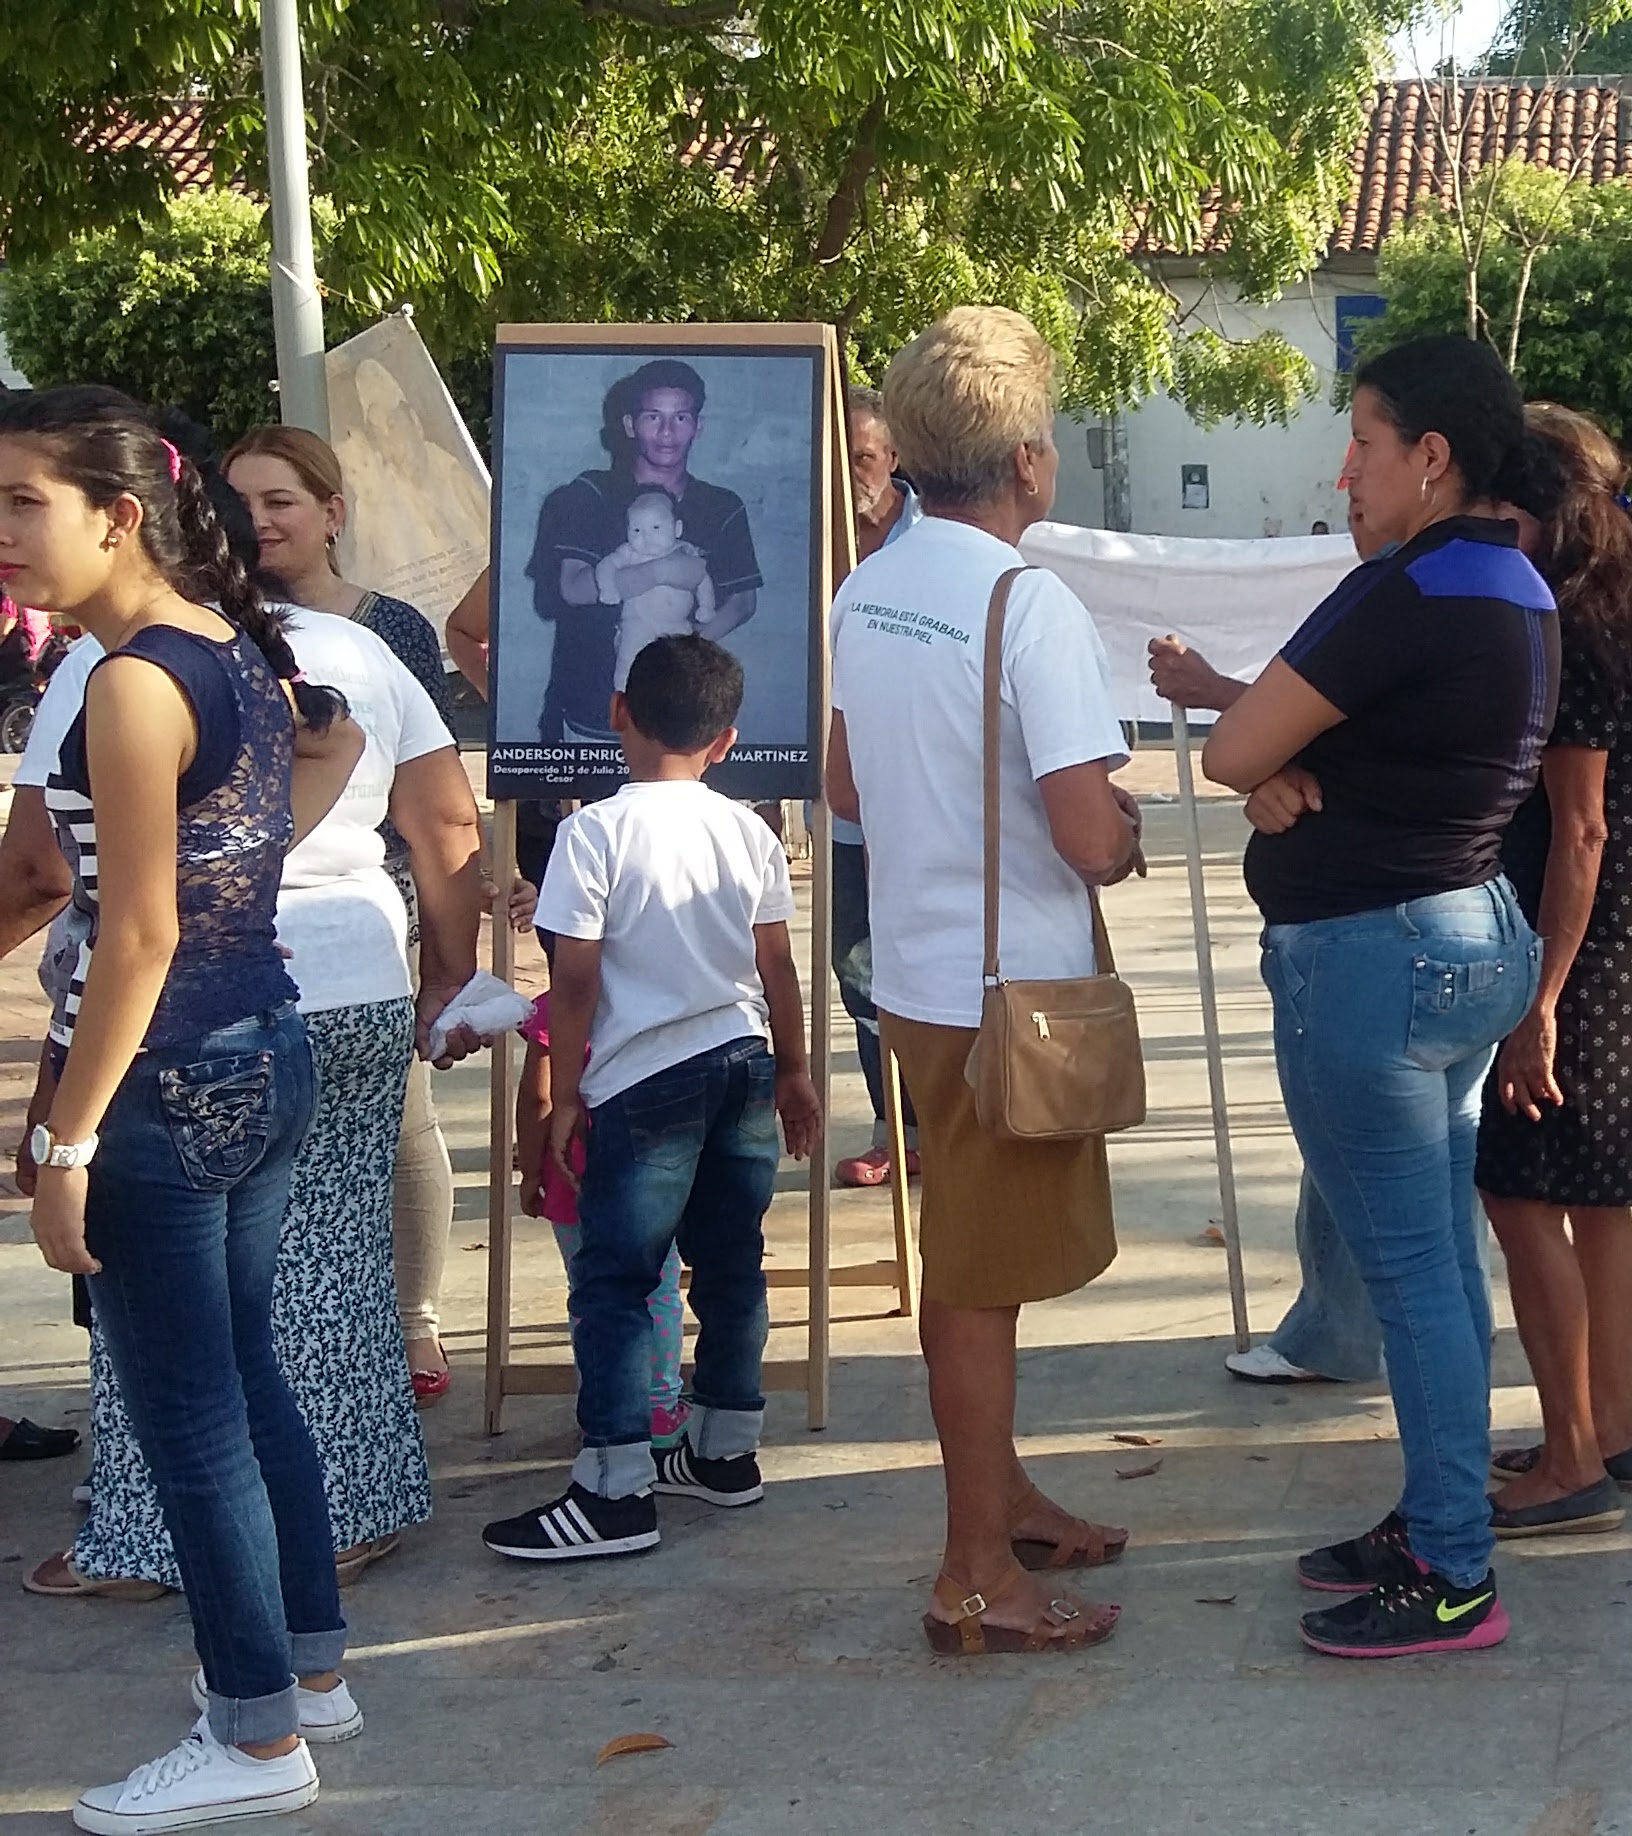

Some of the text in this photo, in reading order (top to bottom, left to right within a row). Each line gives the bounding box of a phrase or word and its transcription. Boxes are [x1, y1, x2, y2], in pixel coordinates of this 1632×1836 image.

[851, 602, 861, 612] LA
[861, 604, 898, 620] MEMORIA
[918, 615, 971, 645] GRABADA
[867, 619, 933, 646] EN NUESTRA PIEL
[491, 748, 809, 764] ANDERSON ENRIQ MARTINEZ
[493, 765, 559, 775] Desaparecido
[562, 765, 575, 774] 15
[577, 765, 589, 775] de
[591, 765, 615, 775] Julio
[546, 774, 575, 783] Cesar
